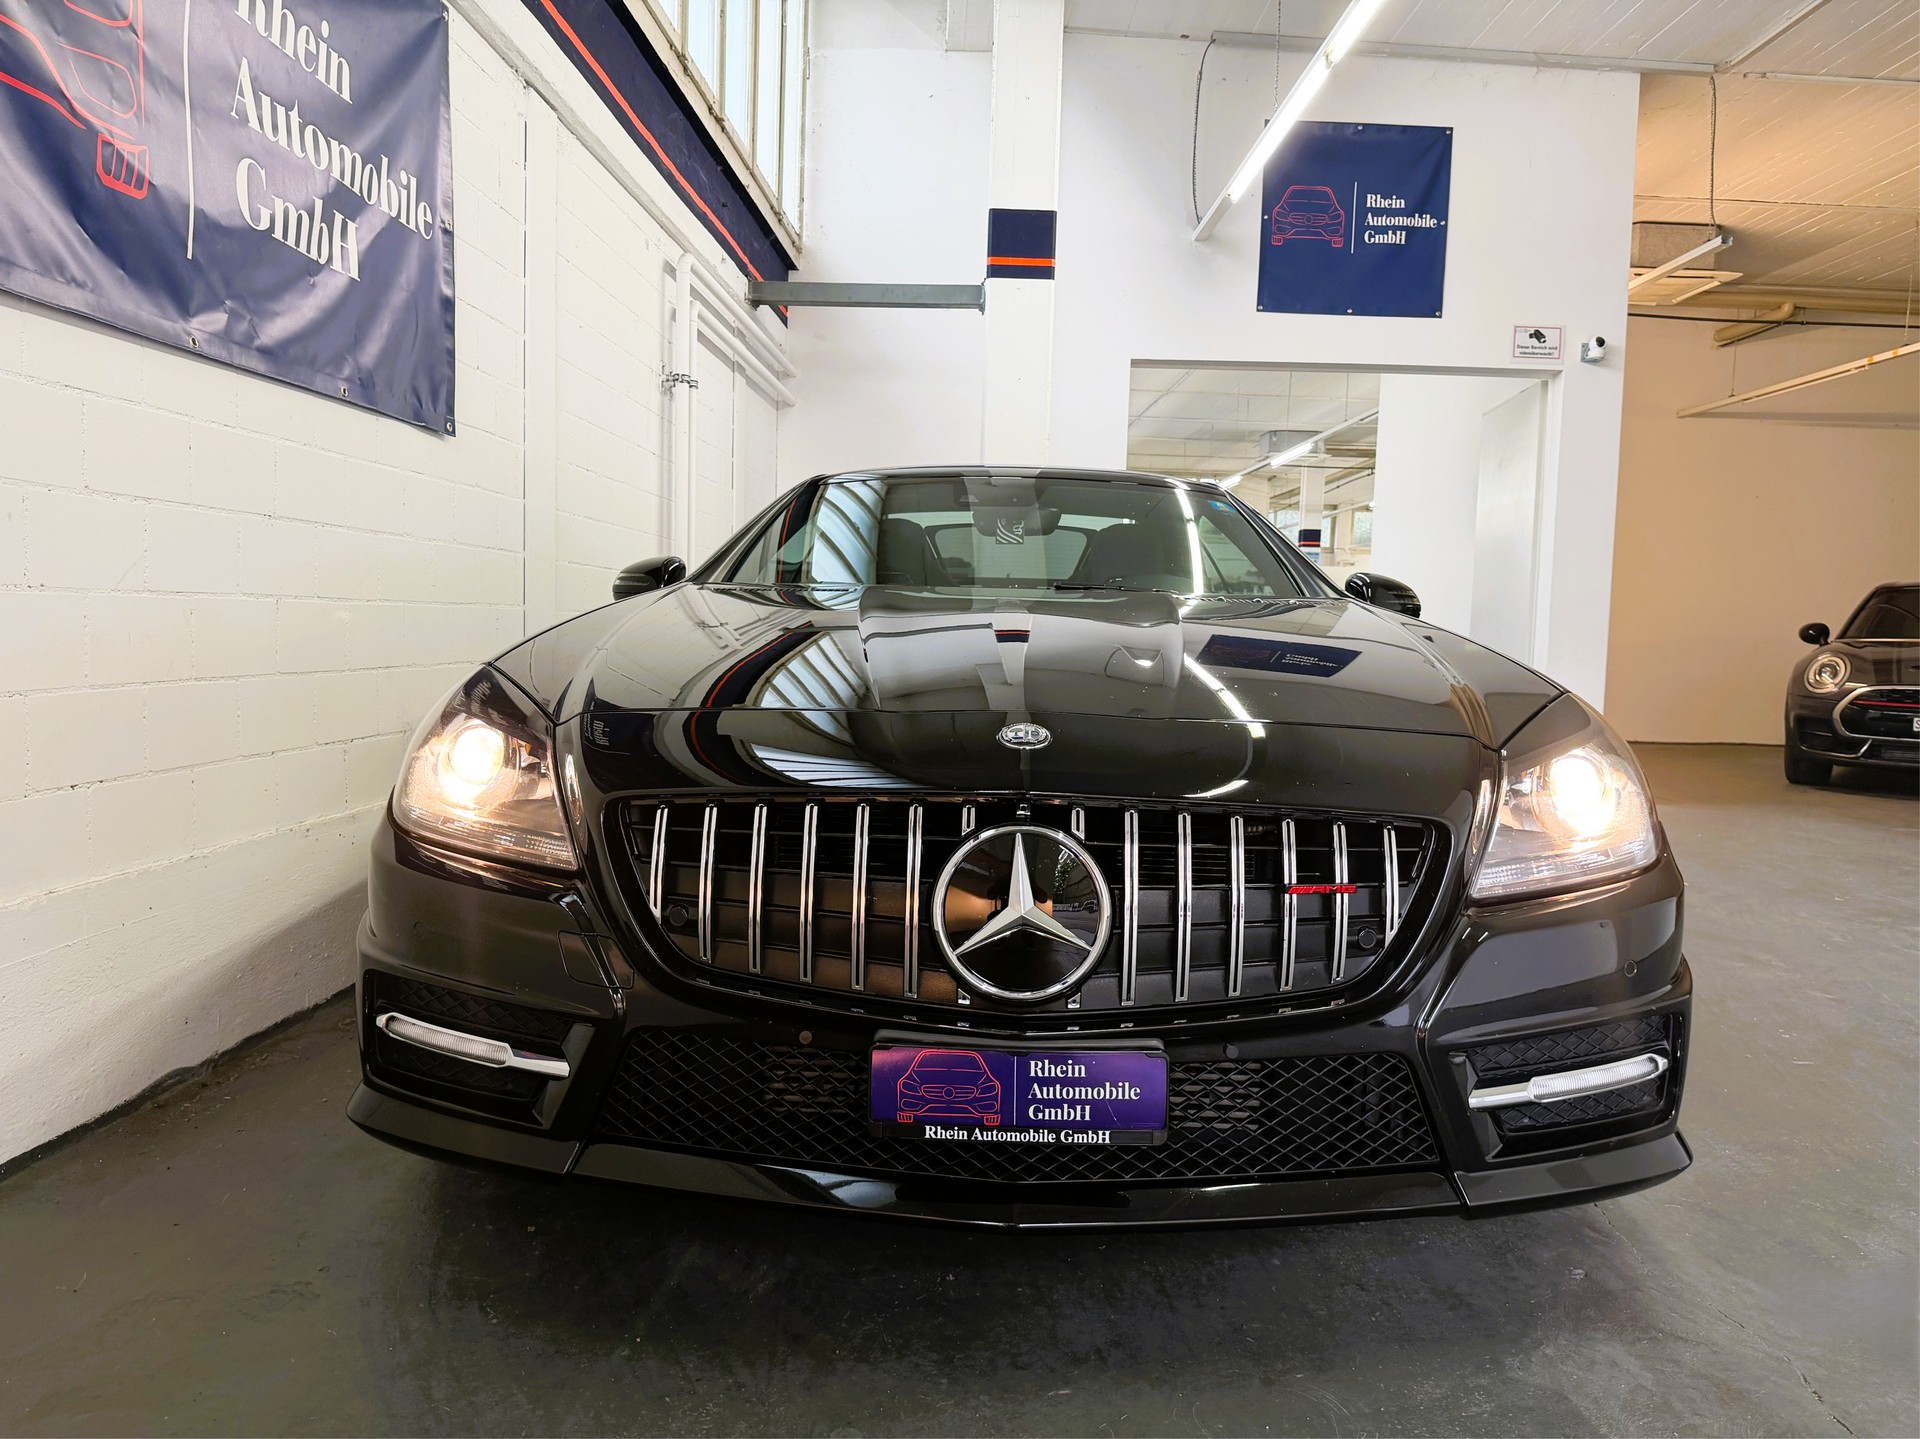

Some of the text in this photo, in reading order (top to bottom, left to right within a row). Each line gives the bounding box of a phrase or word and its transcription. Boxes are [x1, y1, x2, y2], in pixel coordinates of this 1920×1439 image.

[231, 57, 434, 240] Automobile
[1366, 193, 1405, 209] Rhein
[236, 157, 361, 282] GmbH
[1364, 212, 1438, 228] Automobile
[1364, 230, 1406, 245] GmbH
[1028, 1059, 1086, 1078] Rhein
[1028, 1081, 1141, 1100] Automobile
[1028, 1103, 1091, 1121] GmbH
[924, 1125, 1111, 1144] Rhein Automobile GmbH
